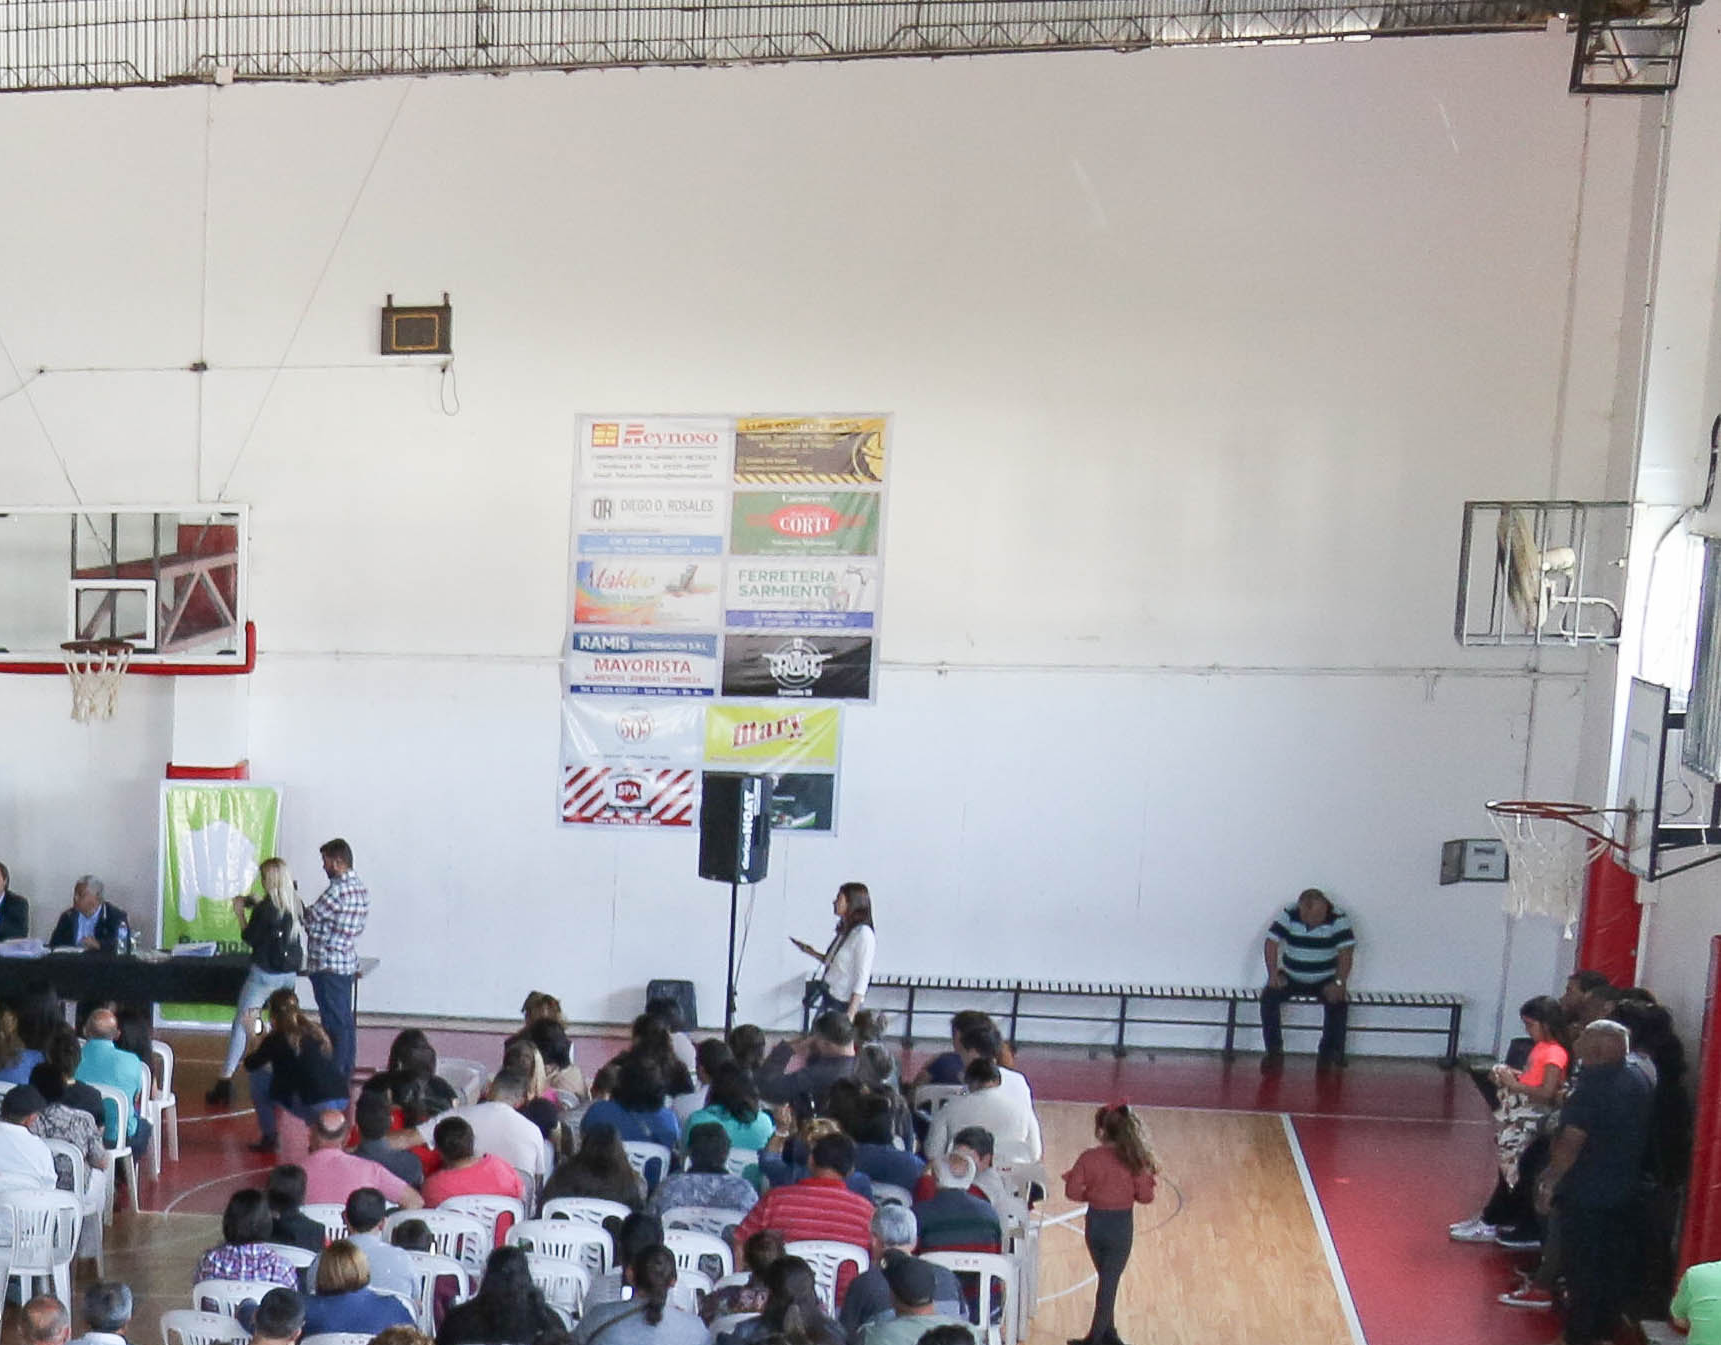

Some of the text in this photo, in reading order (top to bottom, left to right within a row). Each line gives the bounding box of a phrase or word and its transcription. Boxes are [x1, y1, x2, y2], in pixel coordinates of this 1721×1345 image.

[668, 499, 714, 513] ROSALES
[779, 516, 831, 534] CORTI
[580, 636, 630, 651] RAMIS
[594, 658, 692, 674] MAYORISTA
